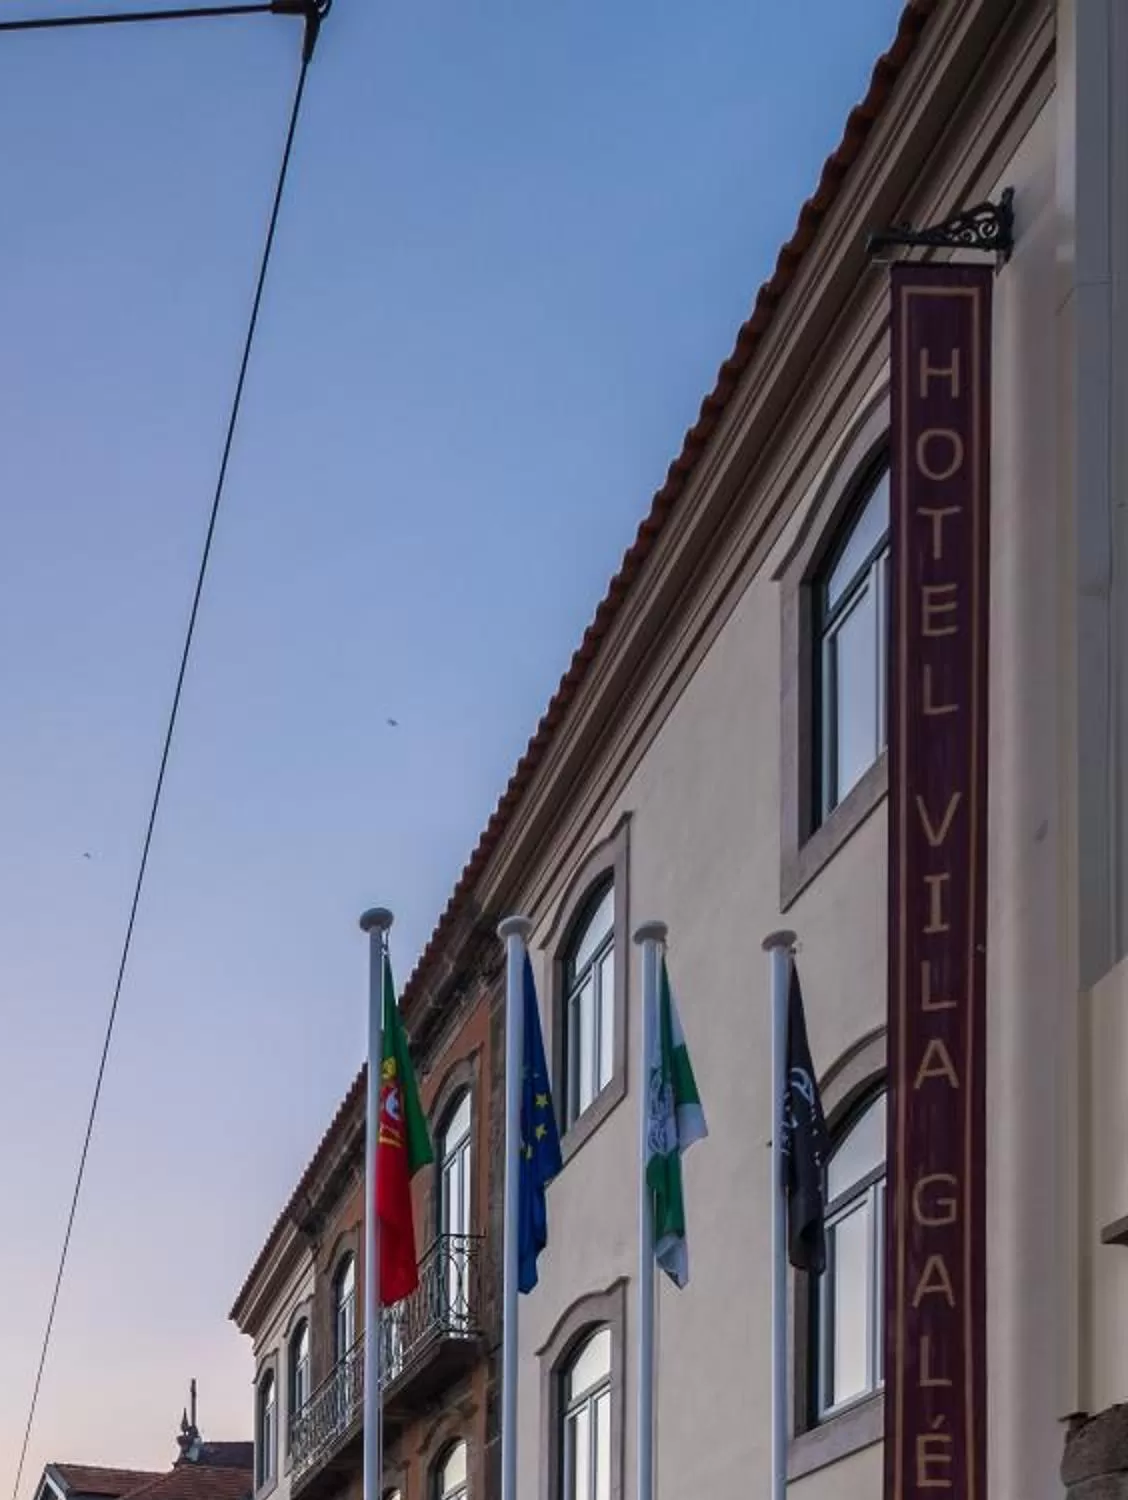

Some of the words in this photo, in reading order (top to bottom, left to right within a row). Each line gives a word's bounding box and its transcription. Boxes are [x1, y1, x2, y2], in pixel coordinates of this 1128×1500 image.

[915, 346, 964, 717] HOTEL
[913, 791, 962, 1090] VILA
[911, 1172, 960, 1489] GALÉ
